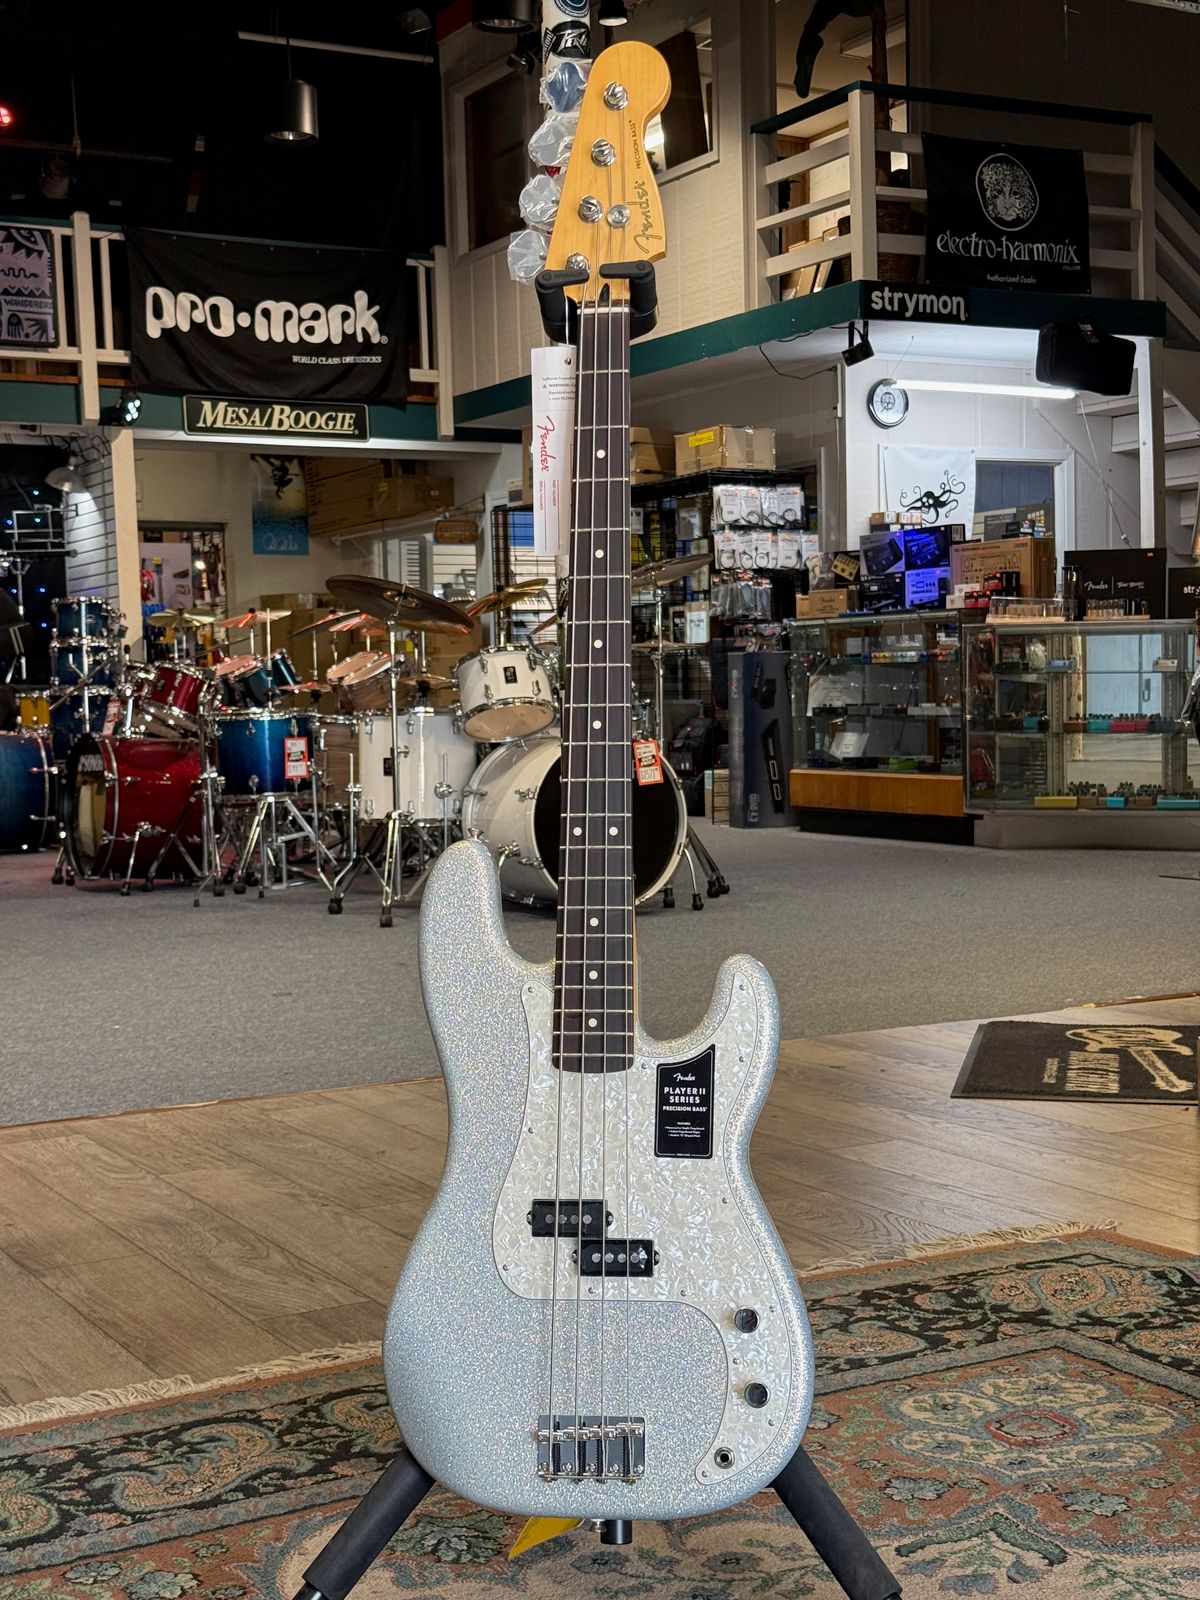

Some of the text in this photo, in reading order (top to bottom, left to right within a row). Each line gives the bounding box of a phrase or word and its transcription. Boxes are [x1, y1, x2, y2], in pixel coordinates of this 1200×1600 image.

[632, 140, 642, 170] PRECISION
[626, 182, 663, 254] Fender
[936, 230, 1080, 263] electro-harmonix
[870, 286, 966, 321] strymon
[292, 355, 318, 364] WORLD
[318, 356, 341, 364] CLASS
[196, 400, 357, 433] MESA/BOOGIE
[537, 415, 557, 472] Fender
[1084, 580, 1109, 592] Fender
[664, 1086, 706, 1095] PLAYER II
[673, 1072, 696, 1082] Fender
[669, 1096, 701, 1104] SERIES
